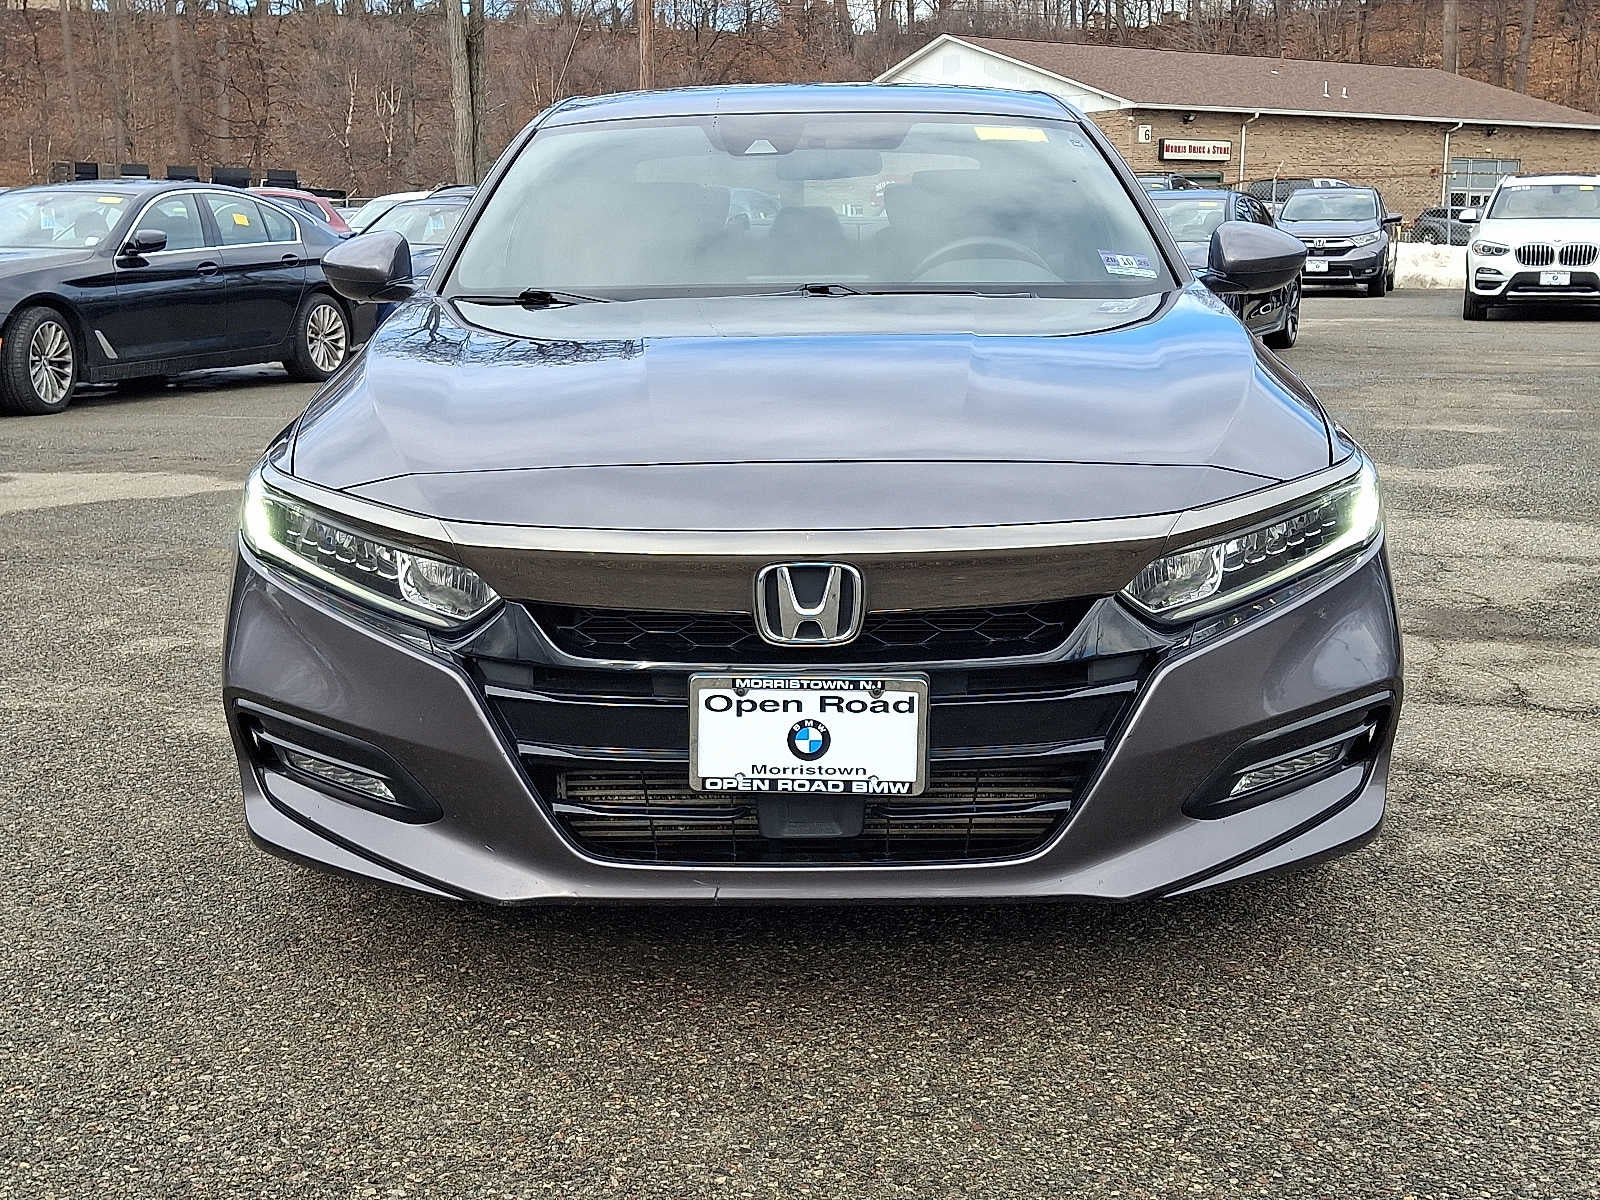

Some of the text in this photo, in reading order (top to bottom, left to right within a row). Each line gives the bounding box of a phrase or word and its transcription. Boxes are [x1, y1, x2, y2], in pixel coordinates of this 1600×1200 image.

[1144, 129, 1150, 141] 6
[1165, 144, 1187, 153] MORRIS
[704, 694, 915, 717] Open Road
[792, 719, 827, 733] BMW
[751, 764, 867, 776] Morristown
[705, 778, 910, 794] OPEN ROAD BMW
